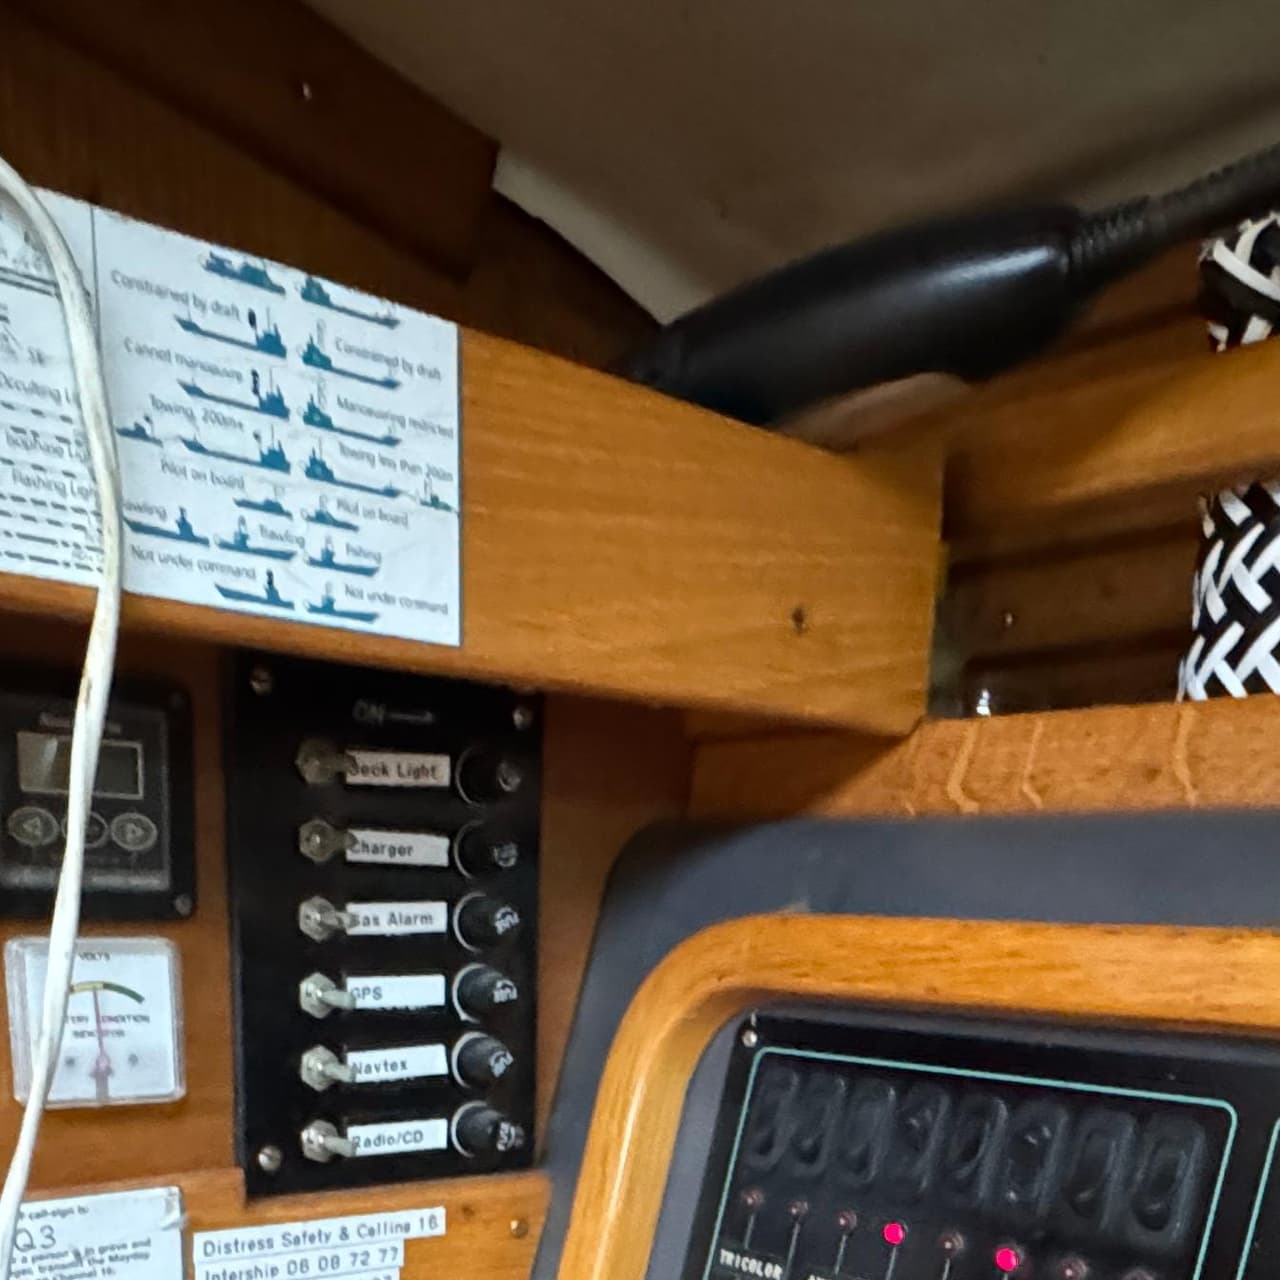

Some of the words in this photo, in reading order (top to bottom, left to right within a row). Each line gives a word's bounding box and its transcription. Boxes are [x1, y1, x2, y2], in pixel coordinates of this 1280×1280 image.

[111, 268, 190, 305] Constrained
[192, 293, 209, 317] by
[211, 298, 241, 321] draft
[123, 336, 172, 364] Cannot
[335, 336, 400, 369] Constrained
[131, 543, 157, 564] Not
[196, 554, 257, 581] command
[344, 583, 365, 601] Not
[396, 762, 439, 782] Light
[386, 910, 434, 926] Alarm
[202, 1237, 275, 1257] Distress
[281, 1229, 333, 1249] Safety
[338, 1226, 351, 1242] &
[356, 1219, 412, 1239] Calling
[418, 1213, 439, 1231] 16
[349, 1251, 371, 1267] 72
[378, 1246, 400, 1263] 77
